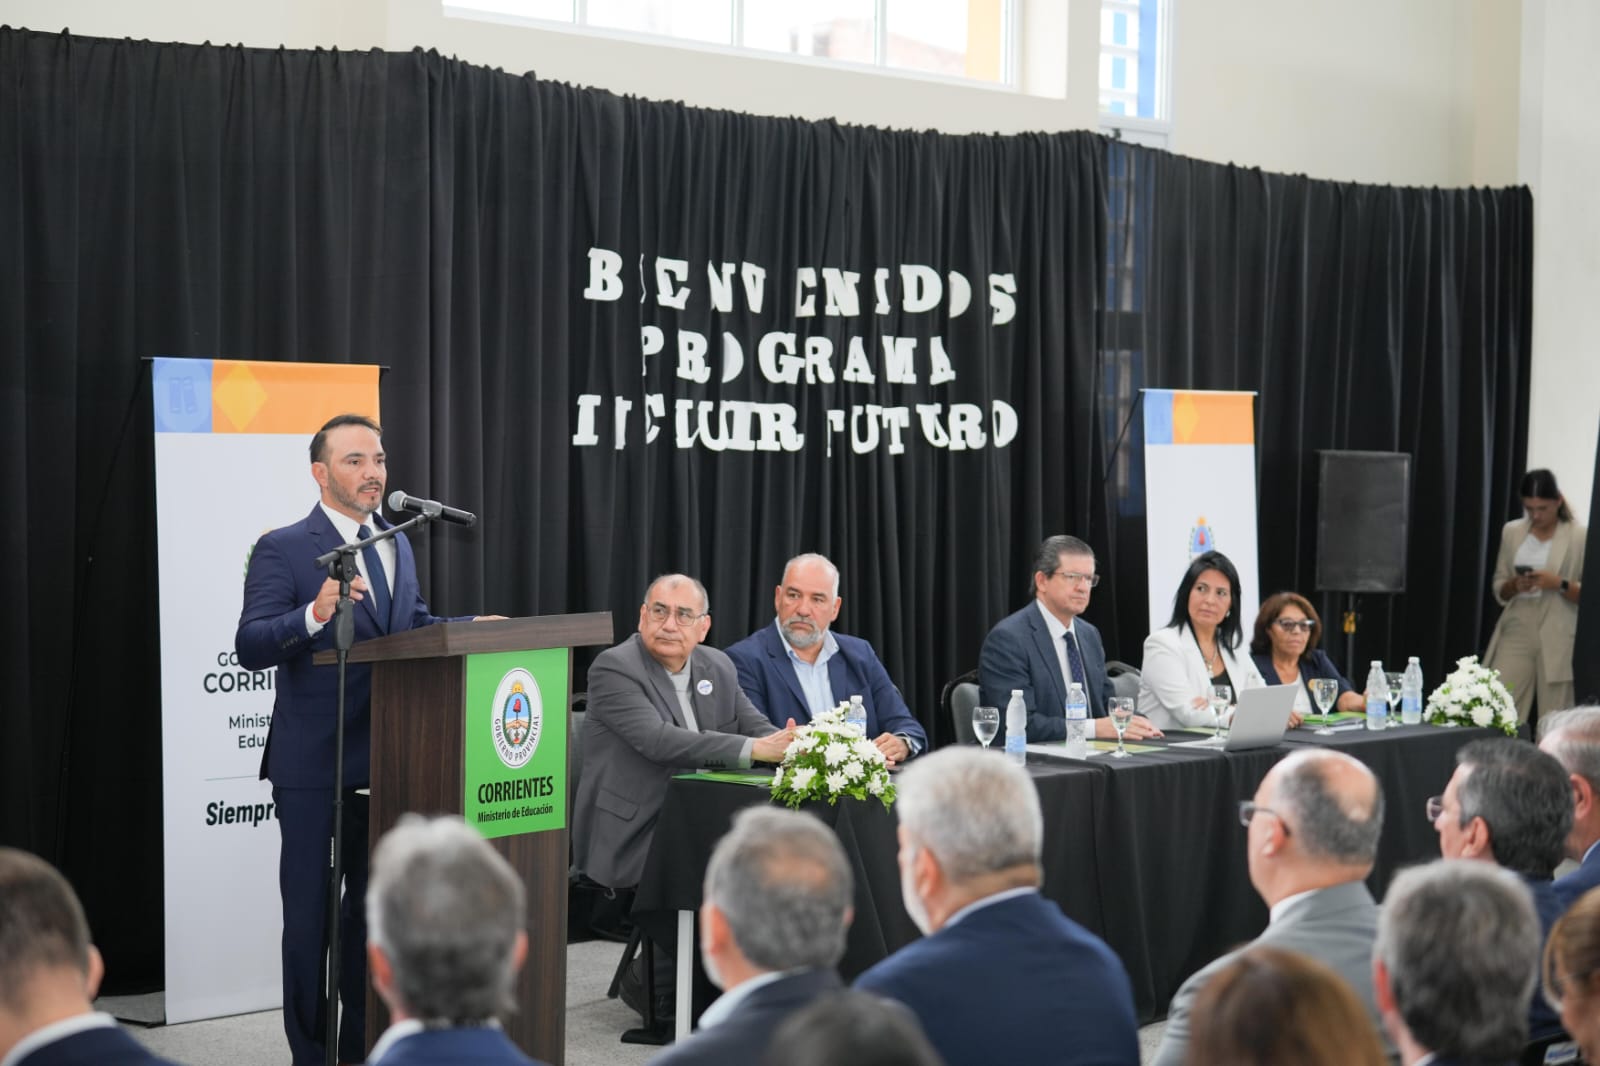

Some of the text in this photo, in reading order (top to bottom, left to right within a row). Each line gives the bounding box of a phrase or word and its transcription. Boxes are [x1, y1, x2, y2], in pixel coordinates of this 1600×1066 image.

[583, 247, 1017, 325] BENVENIDOS
[203, 669, 278, 694] CORRI
[514, 714, 540, 761] PROVINCIAL
[478, 776, 553, 804] CORRIENTES
[478, 803, 553, 823] Ministerio de Educación
